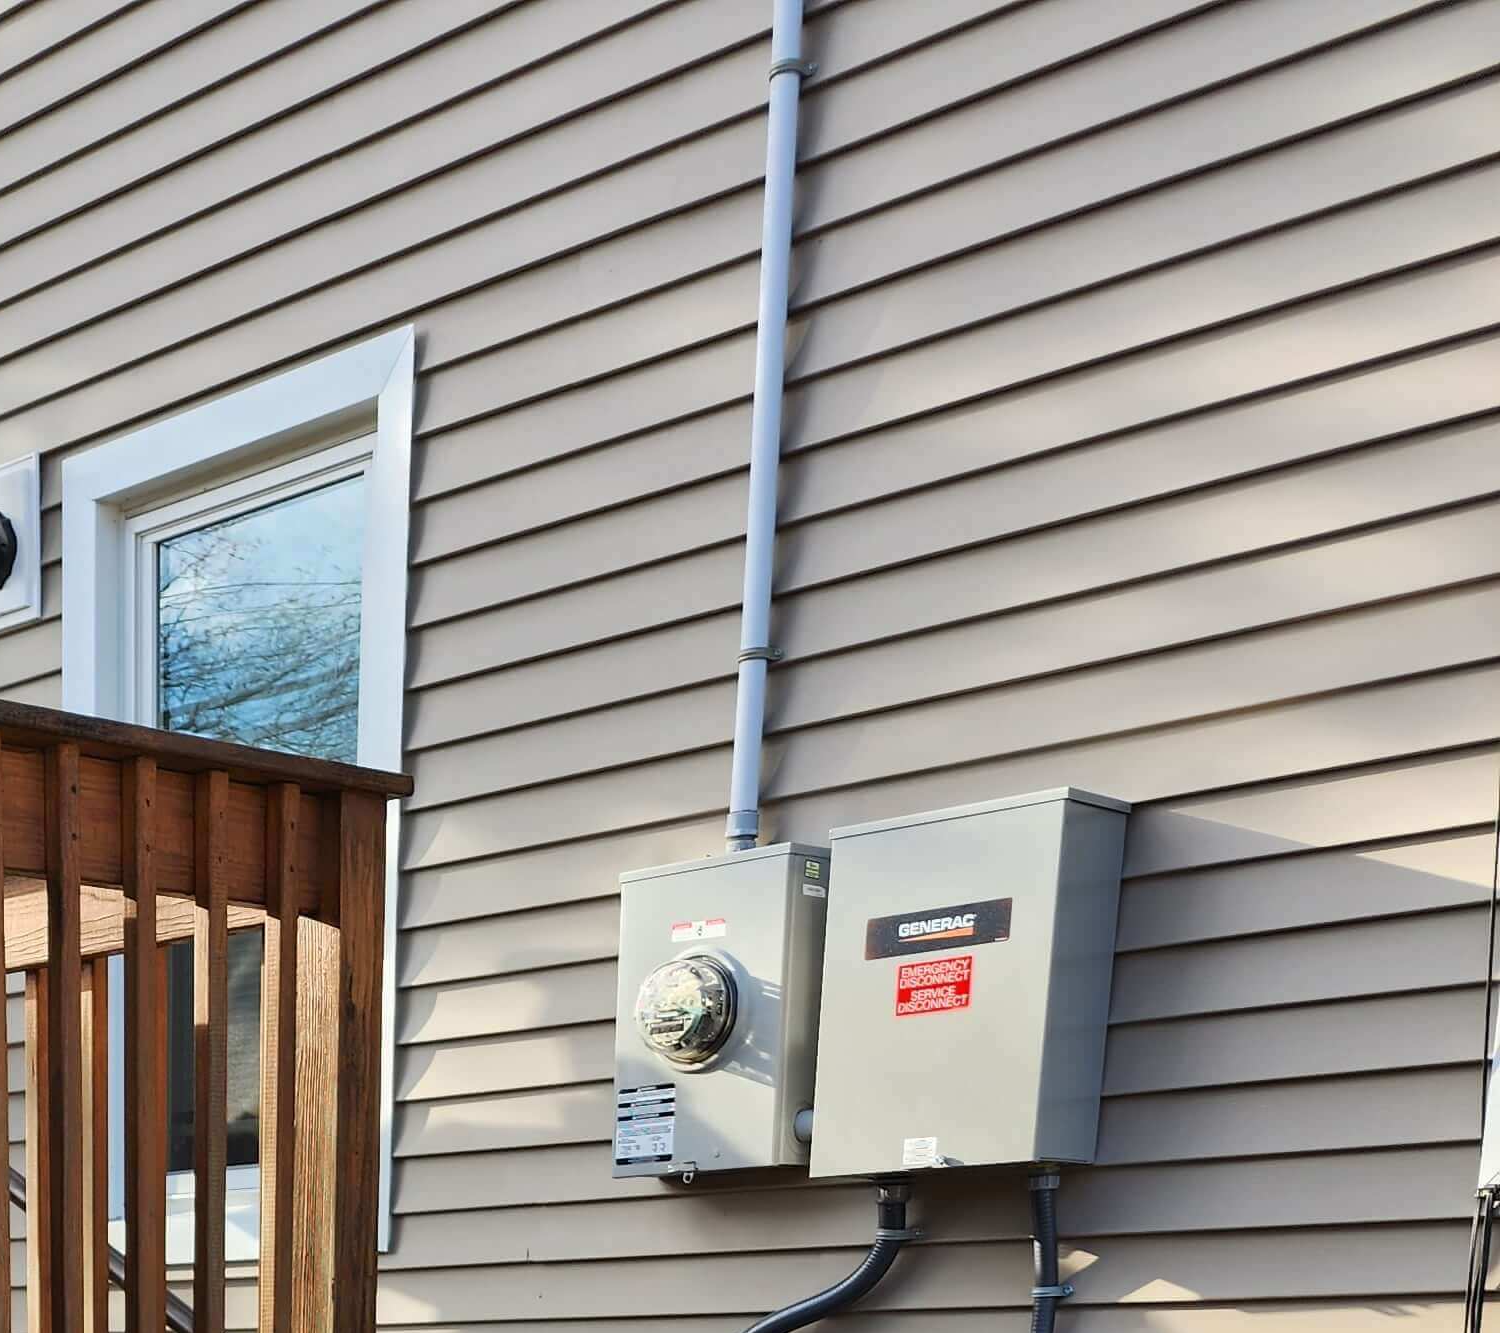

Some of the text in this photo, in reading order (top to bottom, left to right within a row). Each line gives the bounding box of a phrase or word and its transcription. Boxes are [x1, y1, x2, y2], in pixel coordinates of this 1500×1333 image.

[898, 914, 975, 938] GENERAC
[901, 960, 970, 979] EMERGENCY
[900, 970, 970, 989] DISCONNECT
[911, 985, 957, 1001] SERVICE
[897, 994, 968, 1014] DISCONNECT
